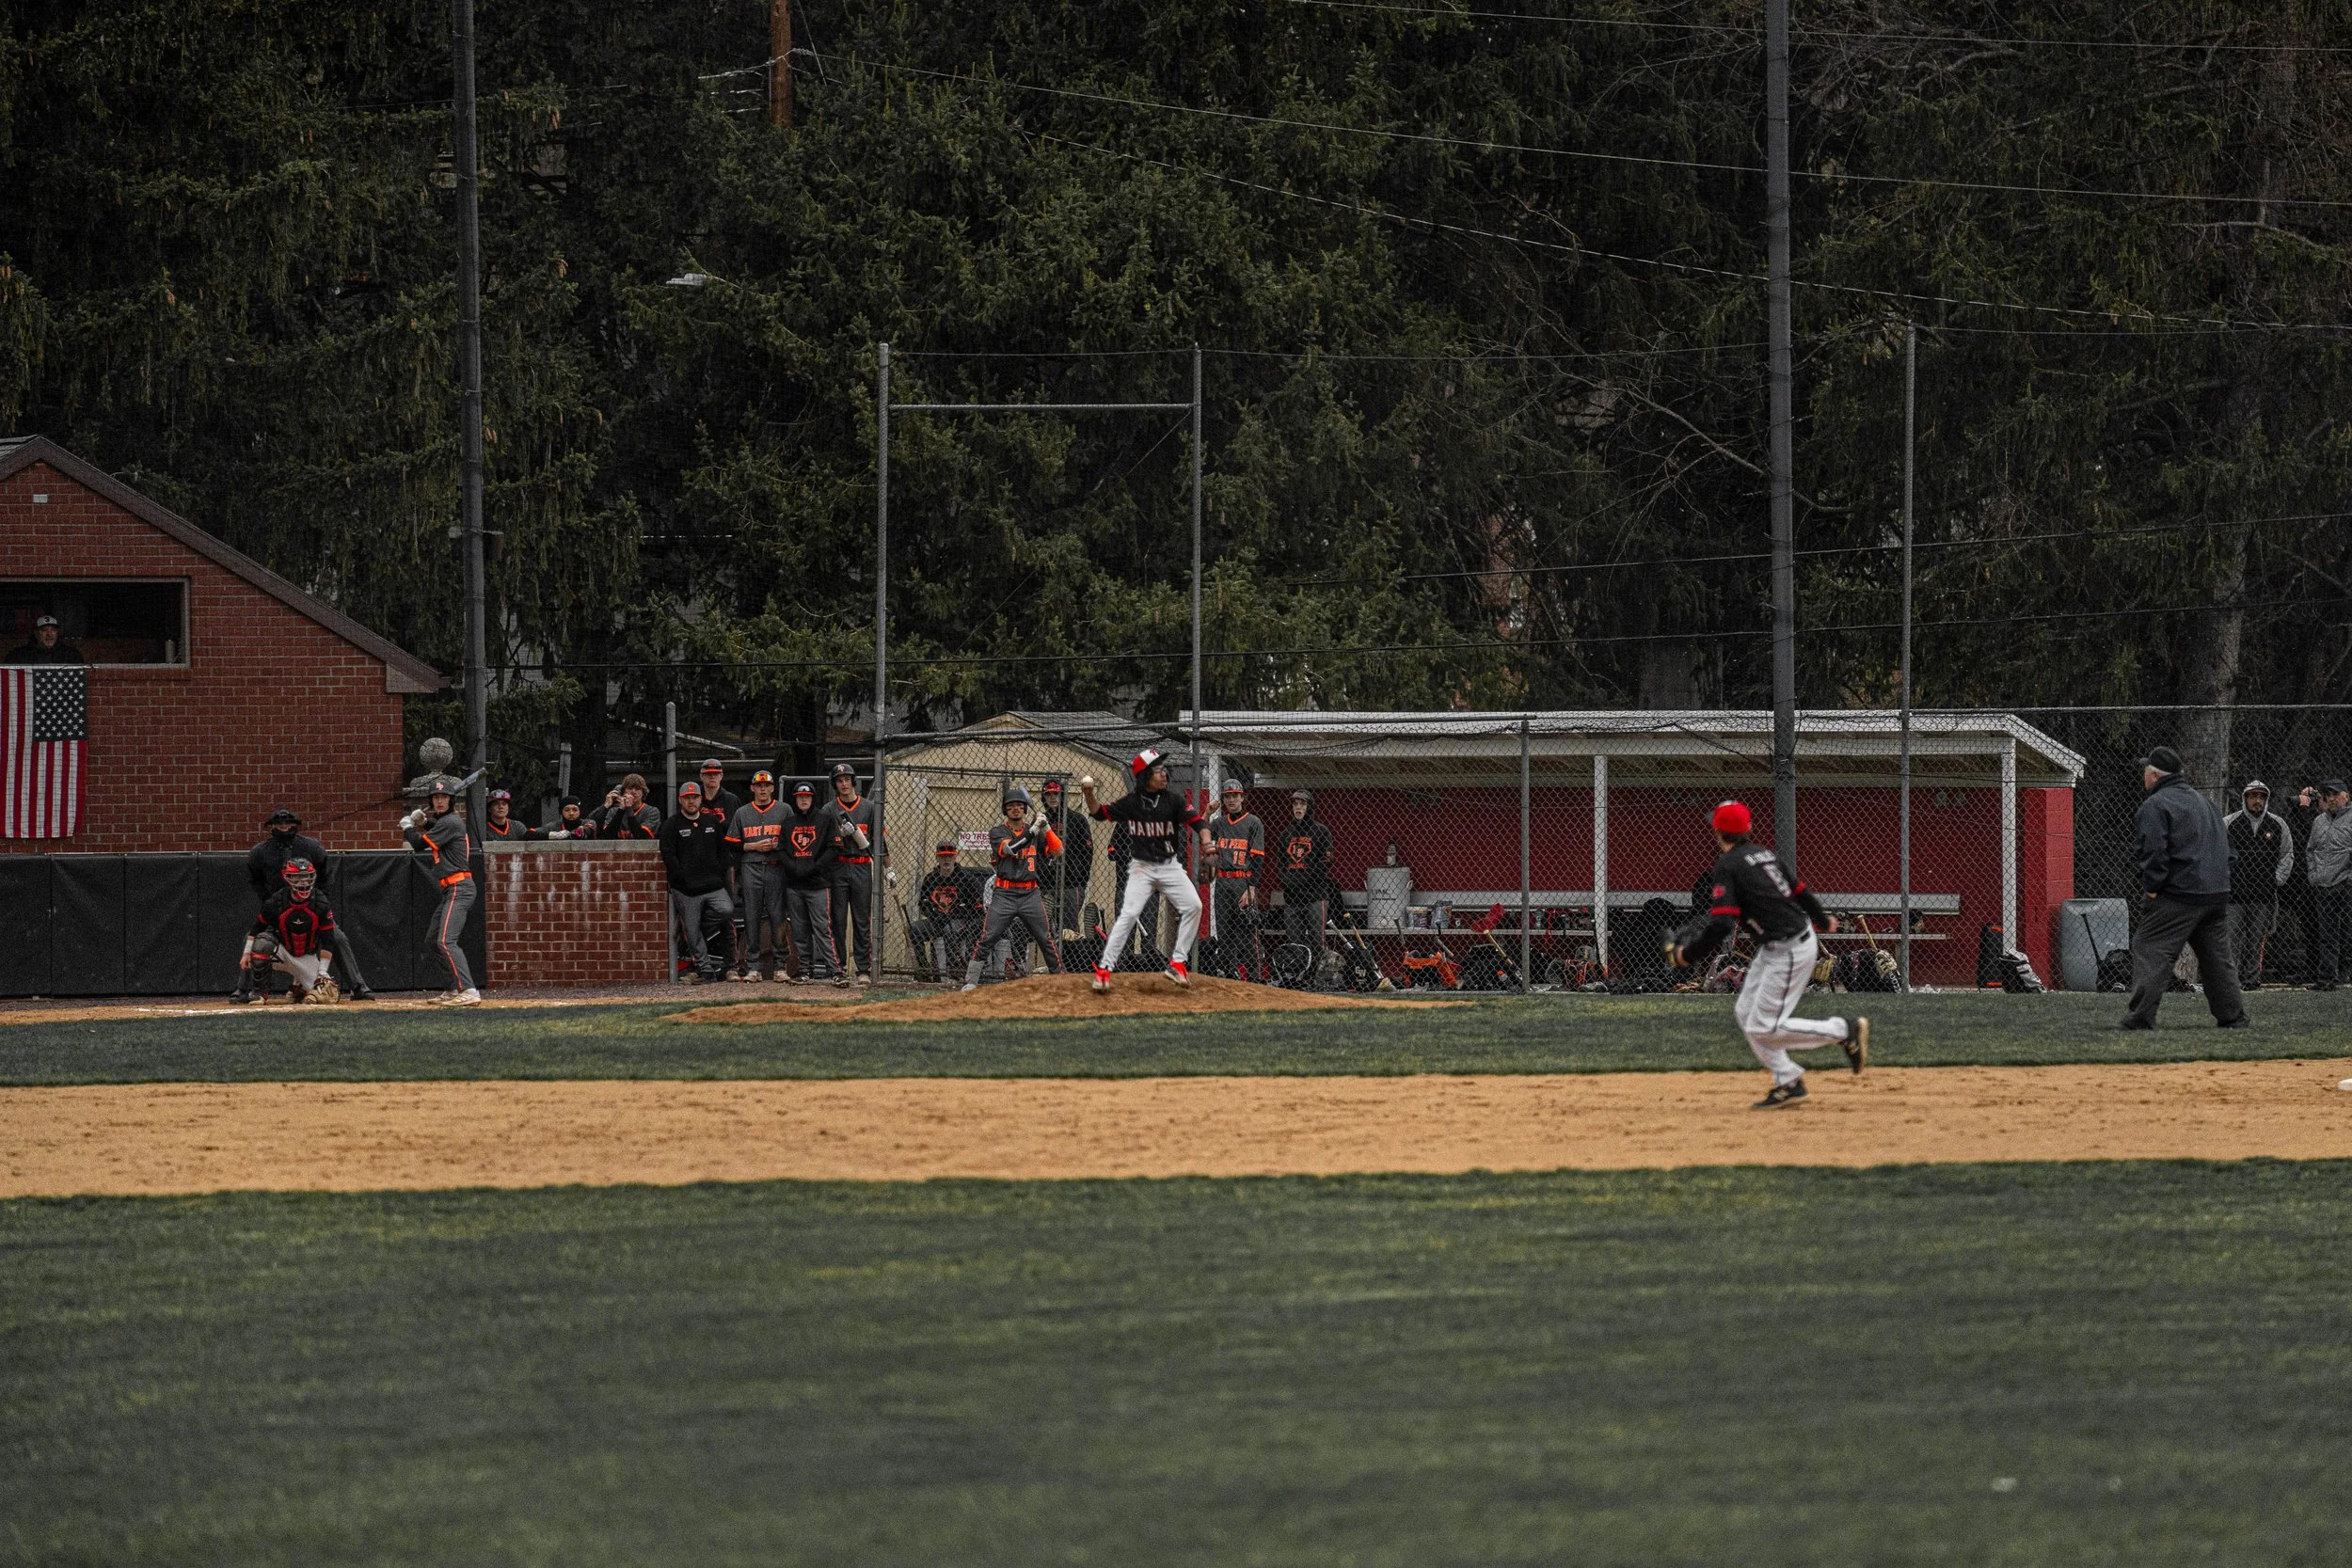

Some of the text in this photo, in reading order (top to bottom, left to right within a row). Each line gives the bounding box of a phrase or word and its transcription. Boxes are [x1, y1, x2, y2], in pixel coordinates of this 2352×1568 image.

[1128, 819, 1175, 837] HANNA
[1027, 857, 1035, 872] 3
[1232, 850, 1247, 865] 15
